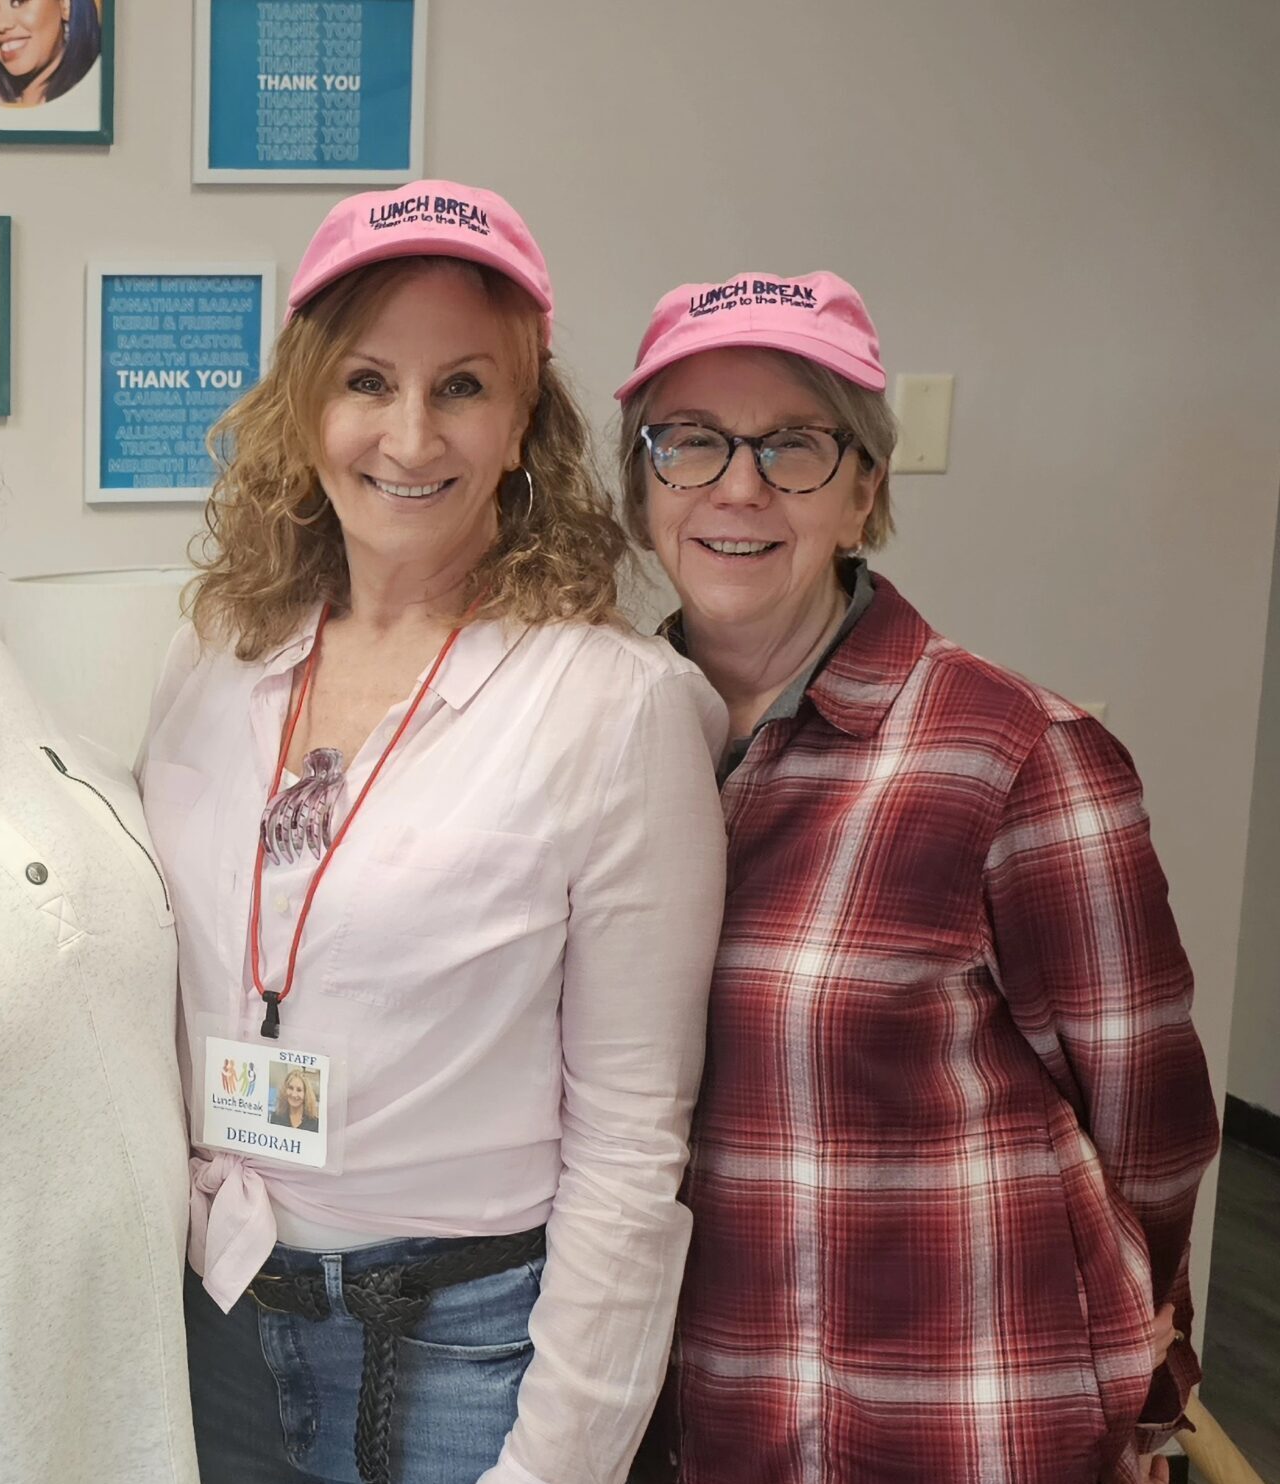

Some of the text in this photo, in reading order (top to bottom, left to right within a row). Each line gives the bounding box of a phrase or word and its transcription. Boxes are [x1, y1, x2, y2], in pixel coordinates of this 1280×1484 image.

[257, 3, 362, 21] THANK YOU
[257, 21, 362, 39] THANK YOU
[257, 39, 362, 57] THANK YOU
[257, 57, 361, 73] THANK YOU
[257, 75, 361, 91] THANK YOU
[257, 92, 360, 109] THANK YOU
[257, 109, 360, 126] THANK YOU
[256, 127, 360, 144] THANK YOU
[256, 145, 359, 161] THANK YOU
[369, 195, 489, 228] LUNCH BREAK
[403, 215, 418, 223] up
[421, 213, 433, 222] to
[435, 214, 456, 224] the
[108, 298, 194, 312] JONATHAN
[689, 280, 817, 313] LUNCH BREAK
[721, 301, 737, 311] up
[739, 296, 753, 306] to
[755, 295, 777, 304] the
[163, 316, 176, 330] &
[117, 335, 243, 349] RACHEL CASTOR
[110, 352, 186, 366] CAROLYN
[116, 370, 242, 388] THANK YOU
[279, 1051, 318, 1066] STAFF
[212, 1093, 237, 1107] Lunch
[238, 1098, 263, 1112] Break
[227, 1127, 301, 1154] DEBORAH
